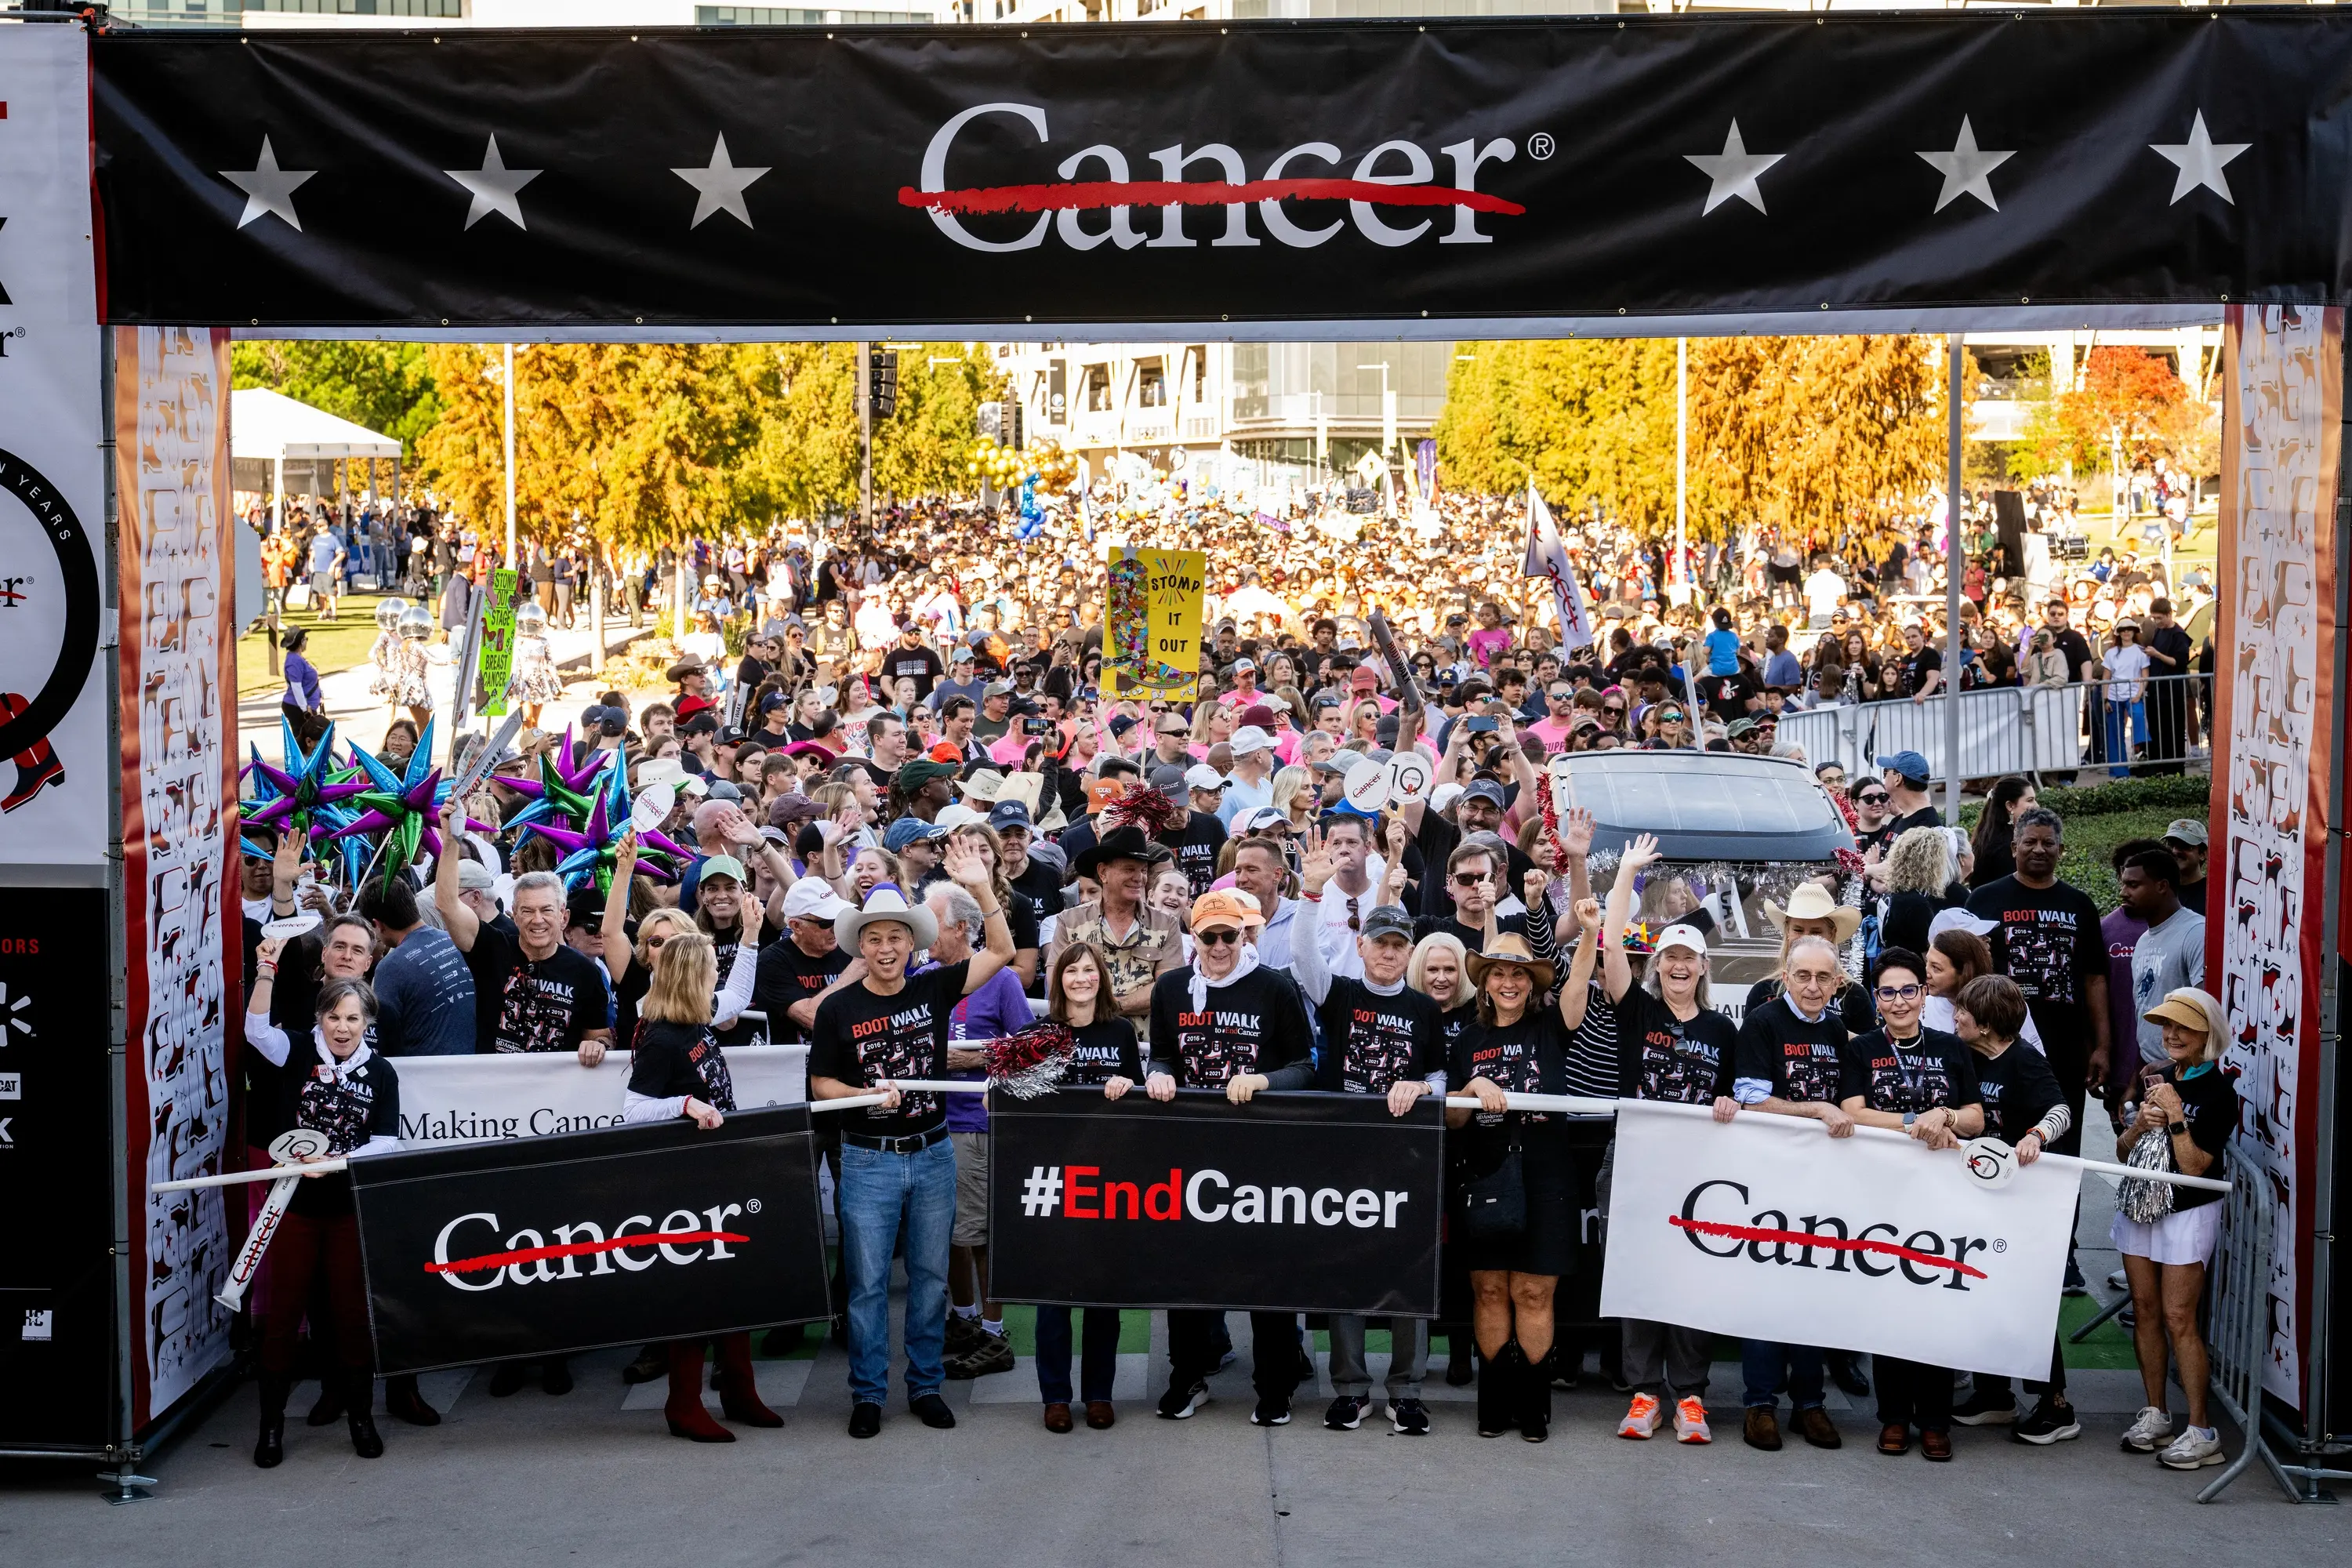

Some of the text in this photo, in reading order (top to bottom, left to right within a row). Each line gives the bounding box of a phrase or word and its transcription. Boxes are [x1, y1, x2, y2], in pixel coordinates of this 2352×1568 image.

[18, 474, 71, 540] YEARS
[495, 572, 517, 590] STOMP
[1151, 575, 1200, 593] STOMP
[496, 590, 508, 607] OUT
[491, 609, 511, 626] STAGE
[1168, 612, 1181, 626] IT
[1160, 638, 1188, 653] OUT
[485, 653, 508, 670] BREAST
[483, 671, 506, 688] CANCER
[1160, 782, 1179, 790] Cancer
[928, 828, 944, 837] GREECE
[1181, 844, 1211, 857] WALK
[2003, 910, 2076, 925] BOOT WALK
[533, 978, 574, 998] WALK
[852, 1004, 931, 1039] BOOT WALK
[1178, 1011, 1260, 1029] BOOT WALK
[1354, 1009, 1414, 1032] OOT WALK
[1077, 1047, 1120, 1060] WALK
[1473, 1047, 1503, 1062] BOOT
[1686, 1040, 1720, 1060] WALK
[1784, 1044, 1835, 1057] BOOT WALK
[1871, 1054, 1944, 1069] BOO WALK
[0, 1080, 18, 1092] CAT
[397, 1109, 626, 1140] Making Cance
[1022, 1166, 1408, 1229] #EndCancer
